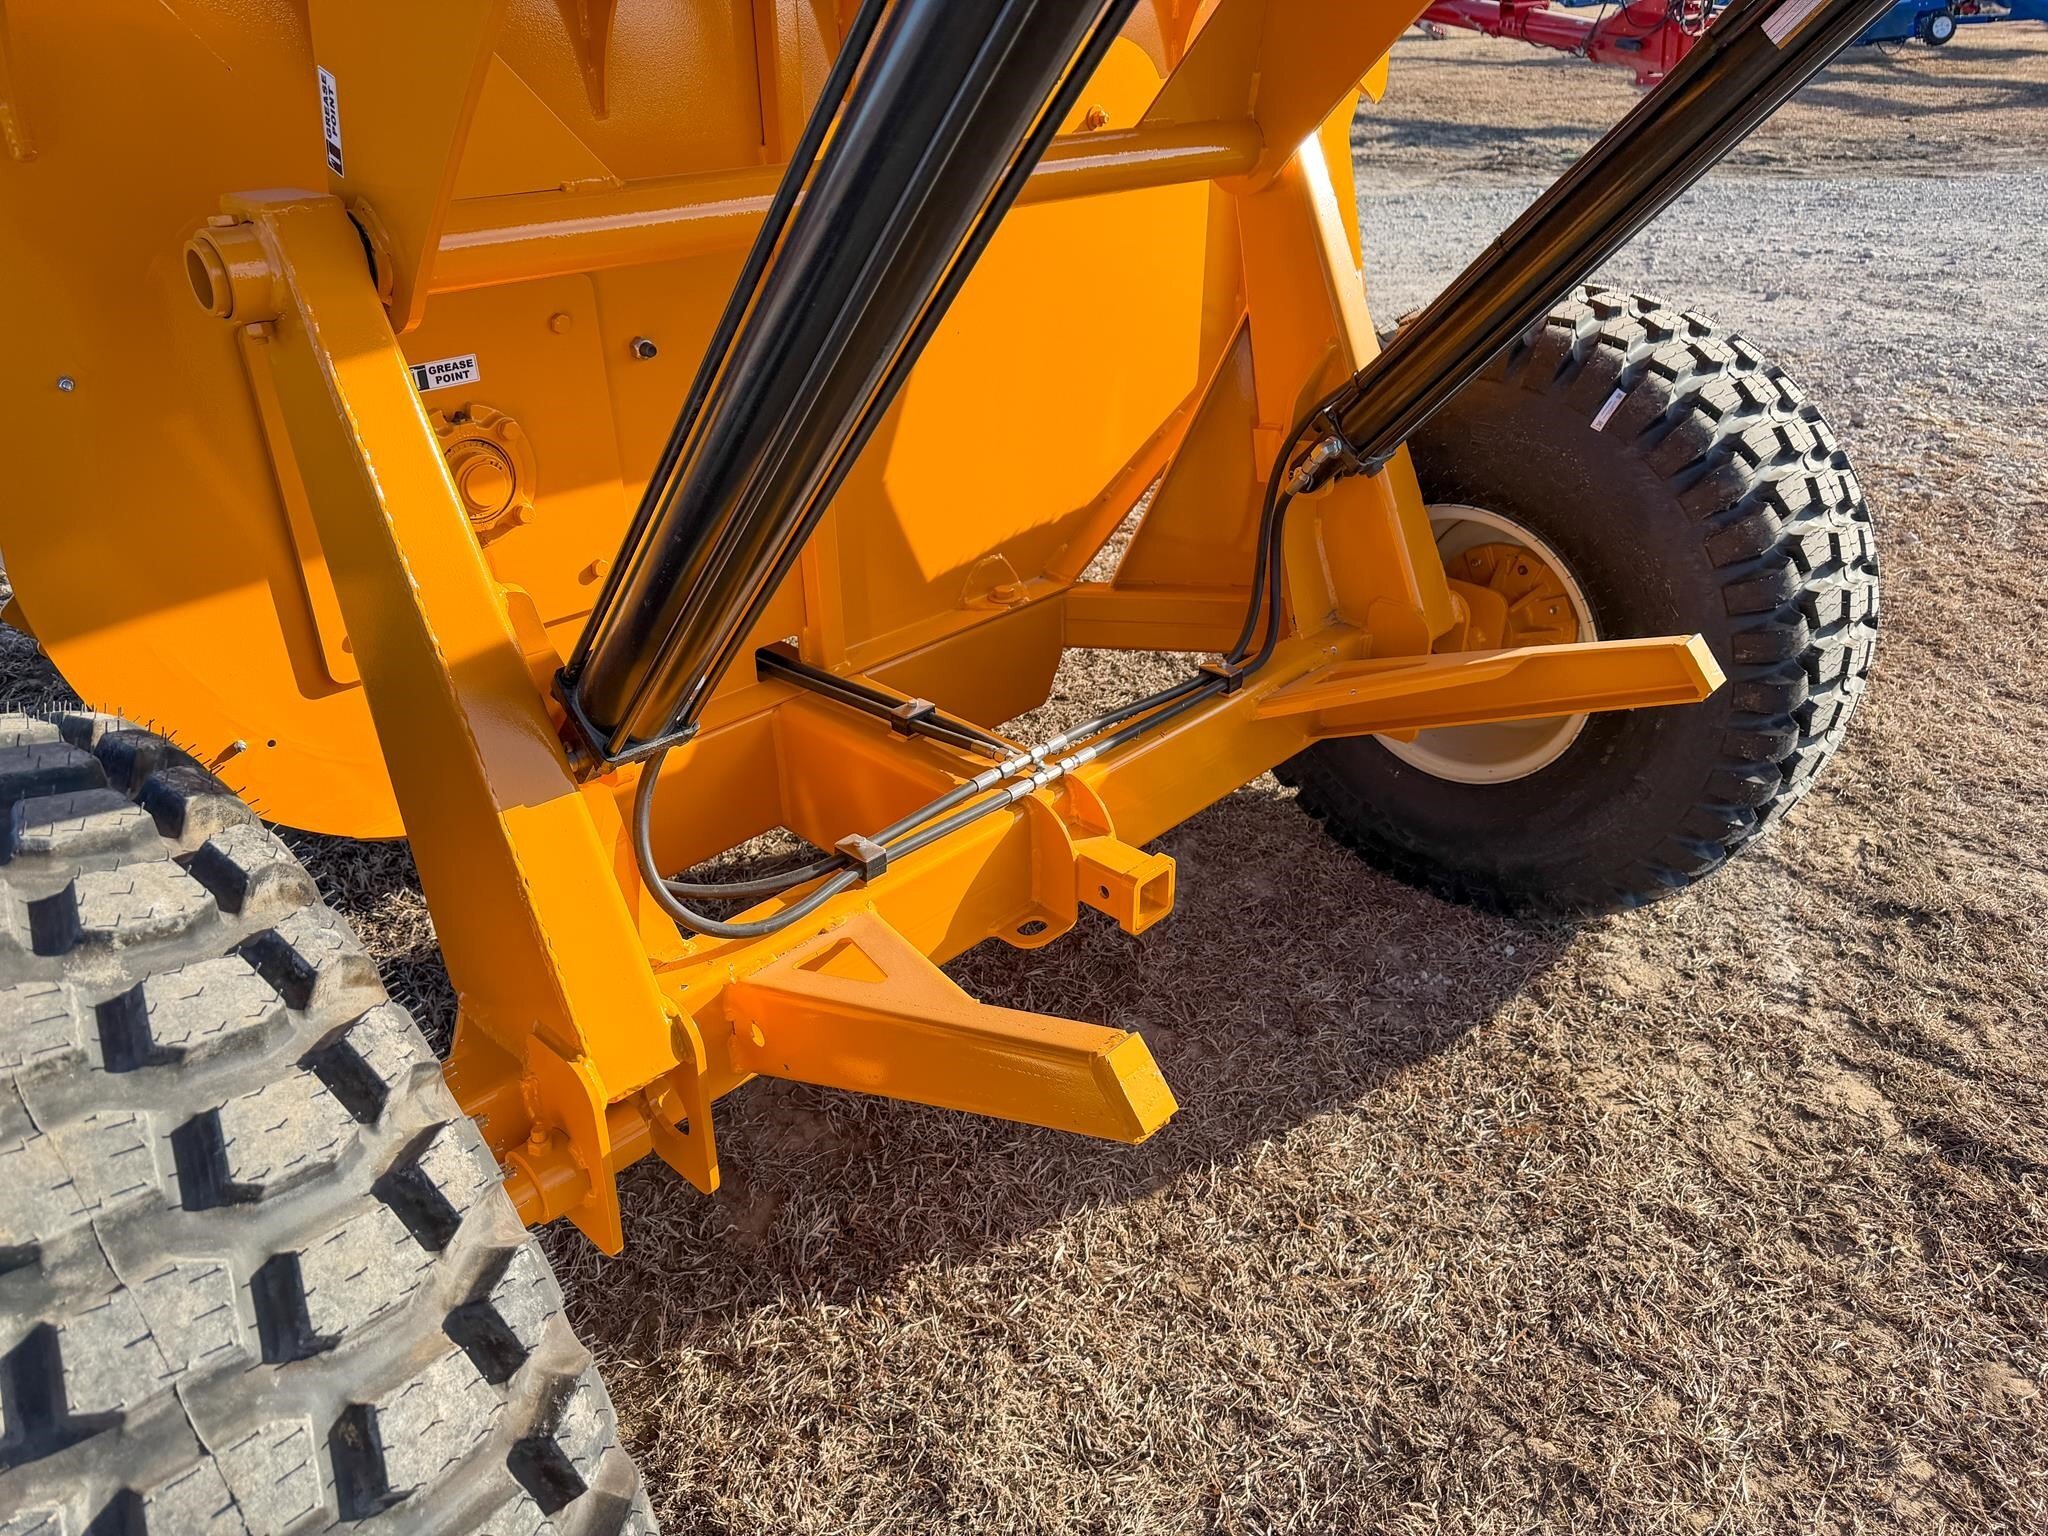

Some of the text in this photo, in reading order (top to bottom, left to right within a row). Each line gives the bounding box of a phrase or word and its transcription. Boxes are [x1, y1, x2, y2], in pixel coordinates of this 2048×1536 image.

[321, 73, 332, 138] GREASE
[327, 85, 338, 137] POINT
[428, 359, 474, 375] GREASE
[435, 370, 470, 385] POINT
